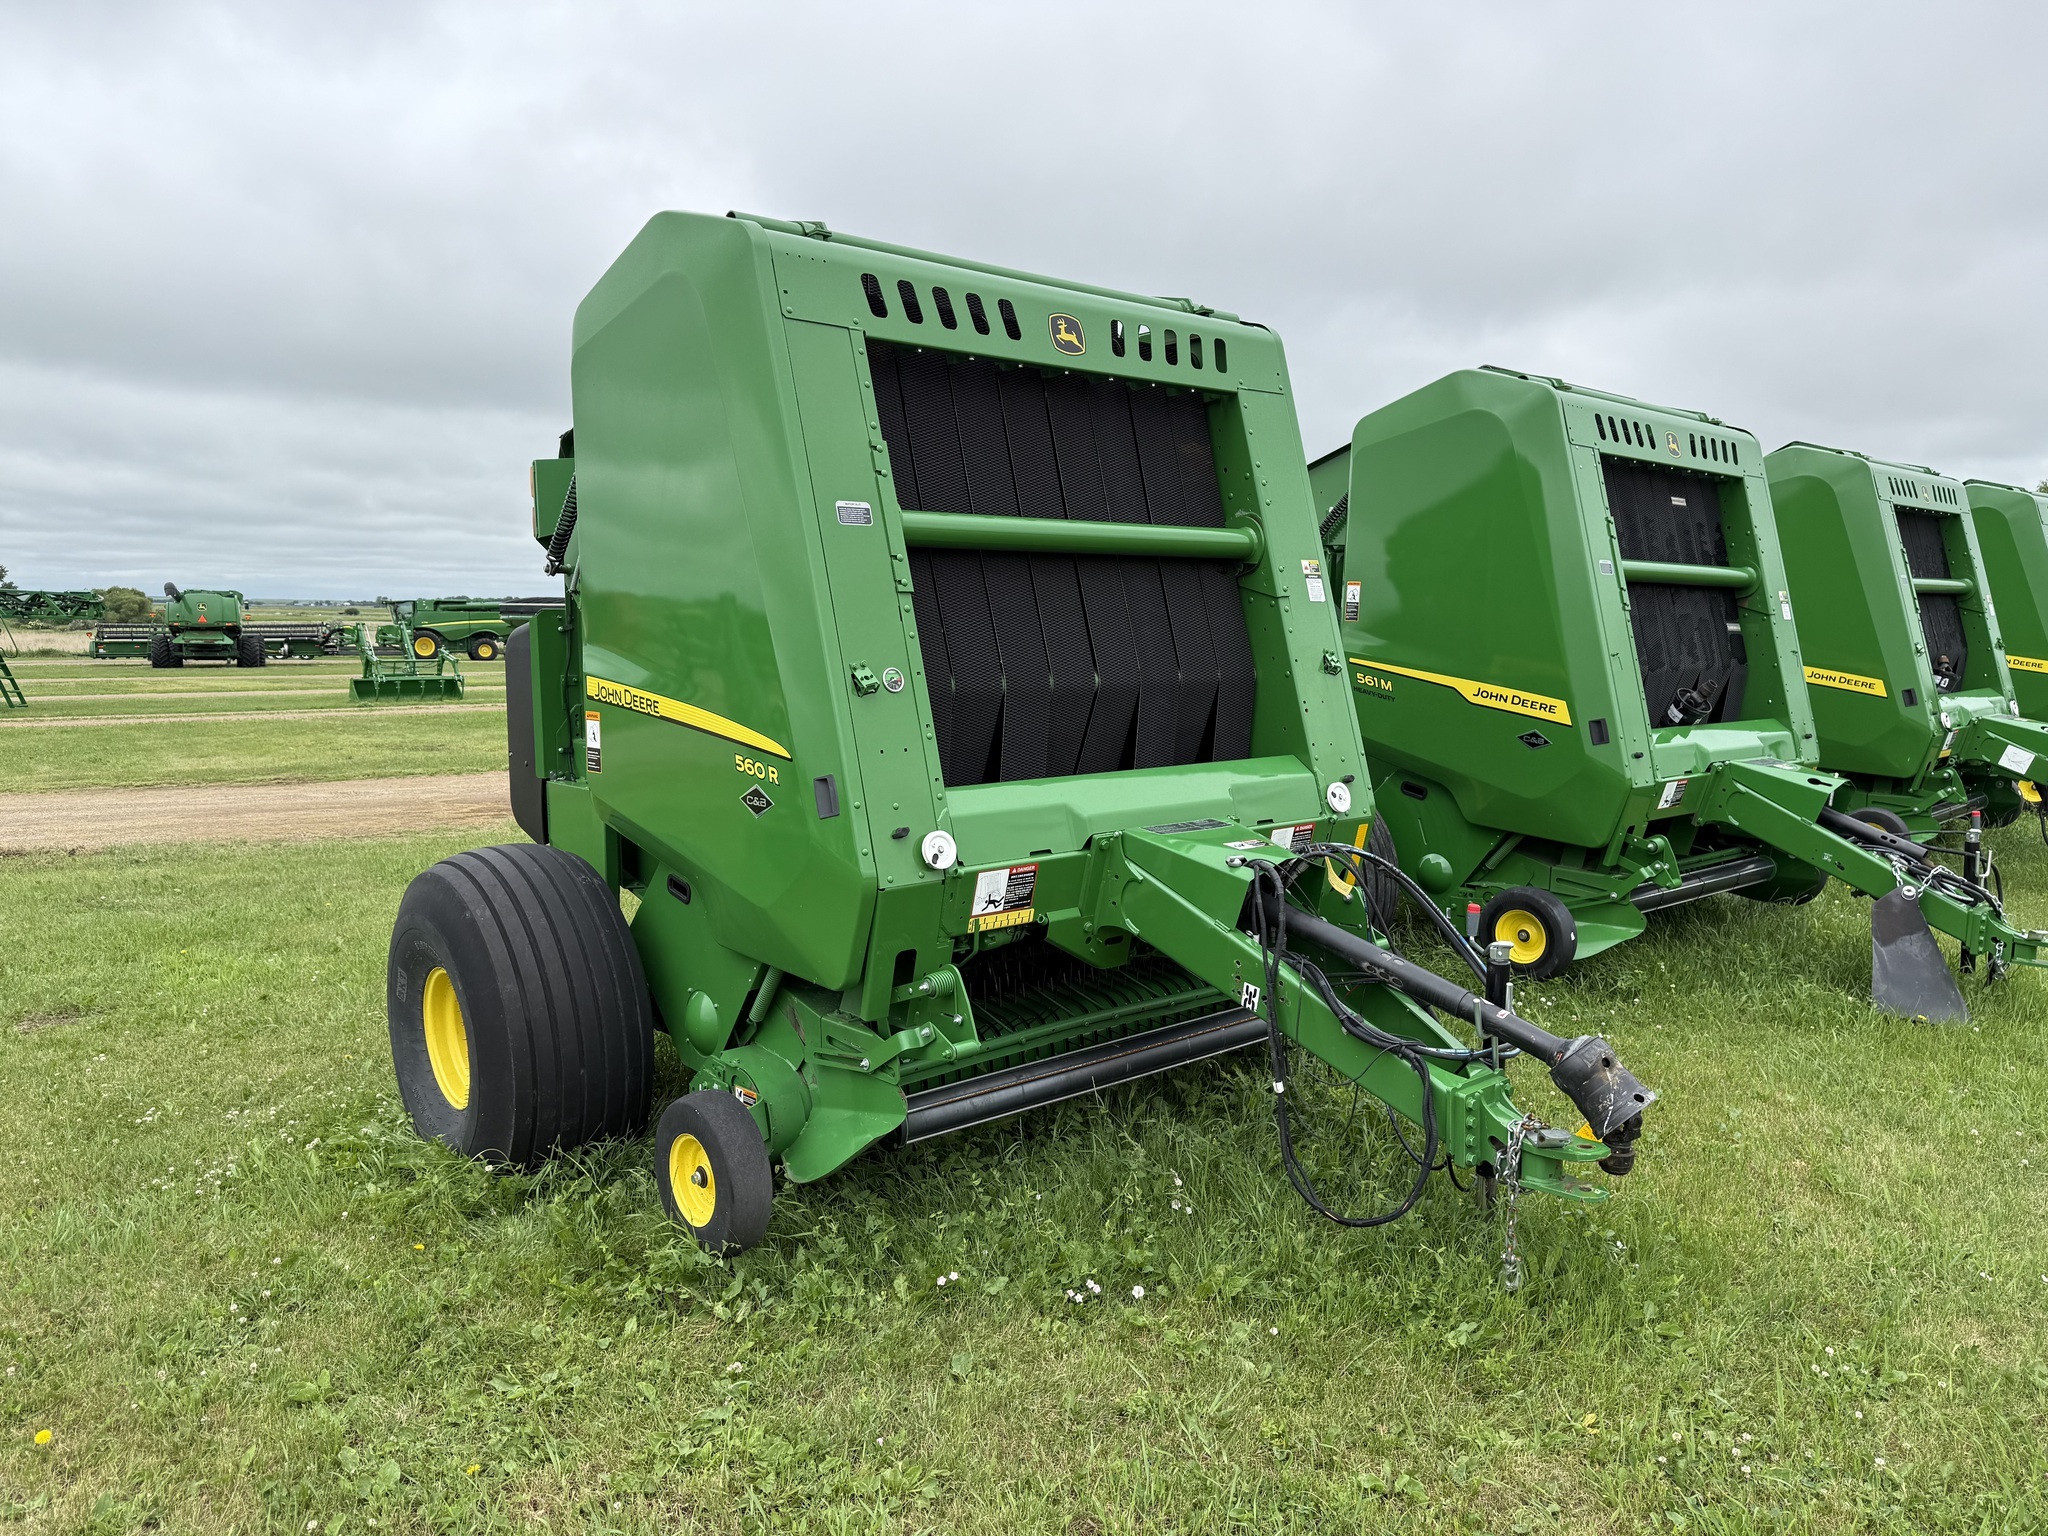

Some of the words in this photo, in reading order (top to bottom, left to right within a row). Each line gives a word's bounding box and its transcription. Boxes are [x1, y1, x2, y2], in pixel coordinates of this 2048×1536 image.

[2012, 658, 2044, 669] DEERE
[1356, 672, 1379, 688] 561
[1380, 678, 1393, 692] M
[1807, 671, 1837, 683] JOHN
[1838, 675, 1876, 690] DEERE
[594, 681, 622, 704] JOHN
[623, 688, 660, 715] DEERE
[1472, 687, 1509, 704] JOHN
[1510, 694, 1558, 715] DEERE
[734, 753, 766, 780] 560
[767, 764, 781, 787] R
